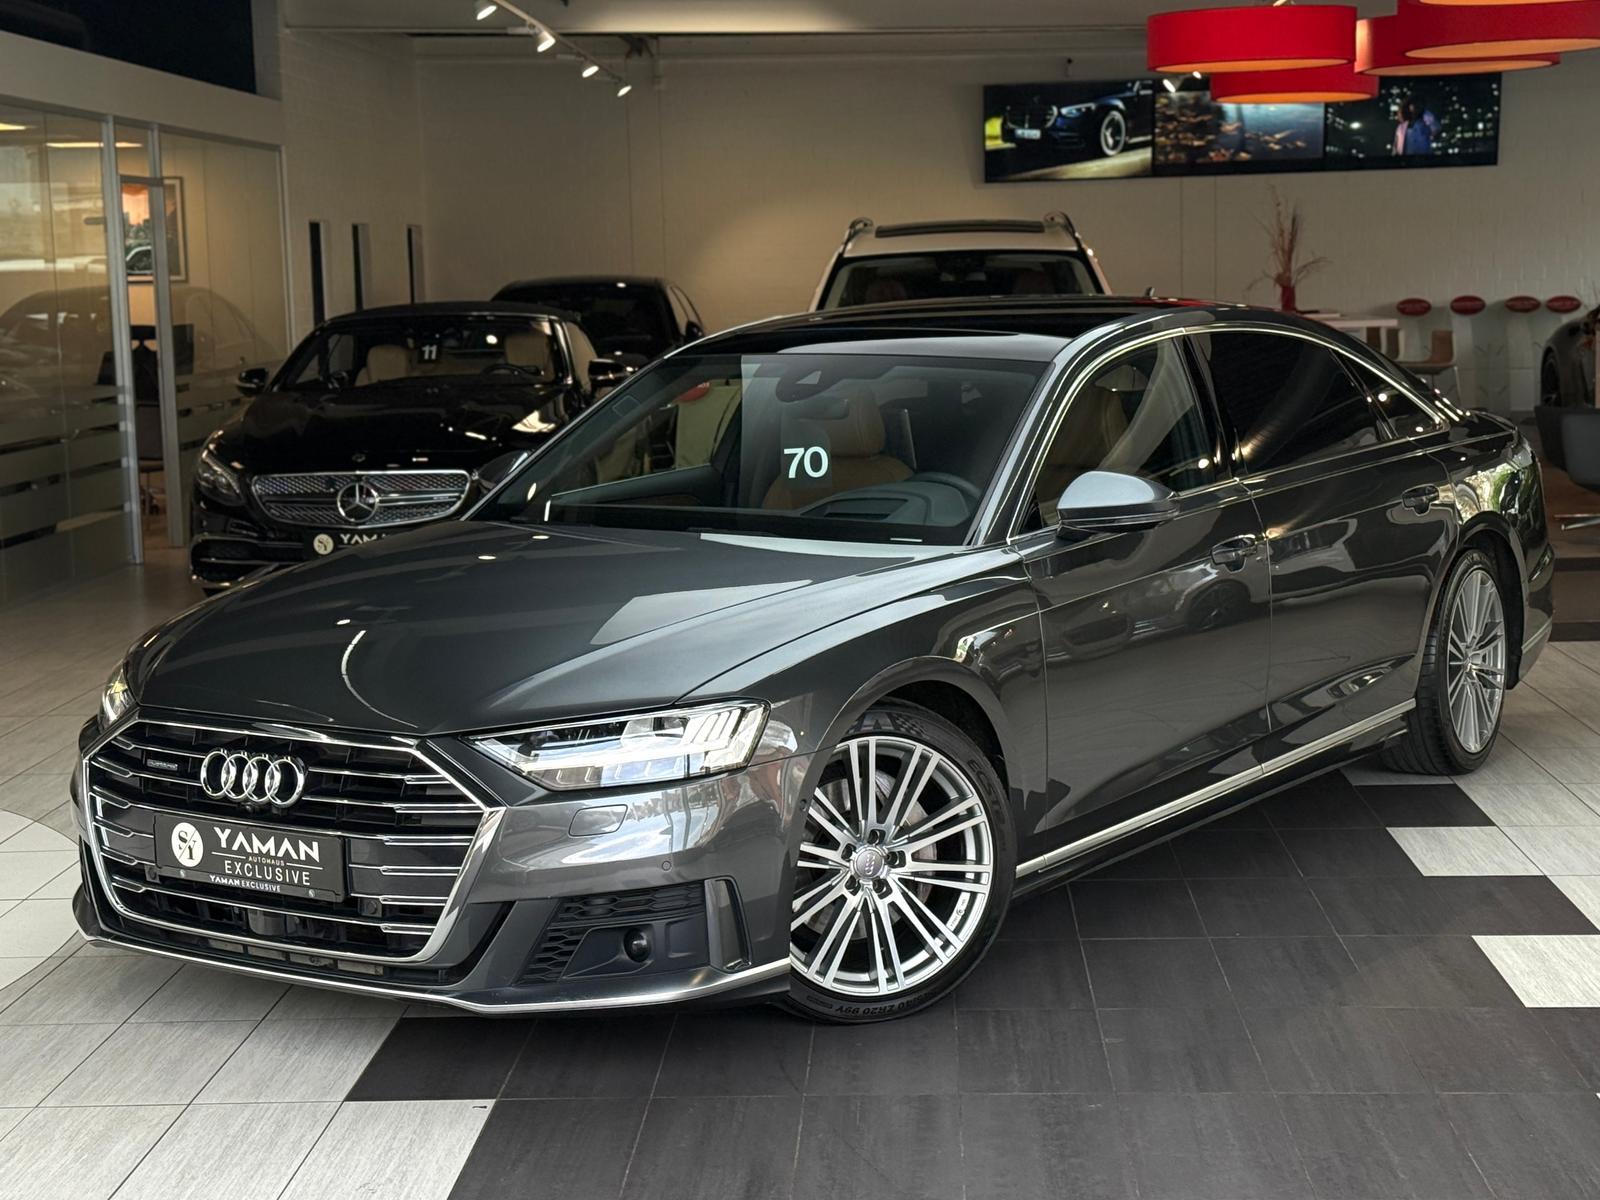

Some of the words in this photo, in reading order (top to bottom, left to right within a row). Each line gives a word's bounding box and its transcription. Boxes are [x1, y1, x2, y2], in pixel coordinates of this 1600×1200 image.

[421, 344, 438, 360] 11
[783, 446, 829, 479] 70
[340, 533, 391, 545] YAM
[213, 826, 320, 863] YAMAN
[248, 856, 285, 867] AUTOHAUS
[224, 860, 311, 886] EXCLUSIVE
[209, 874, 241, 888] YAMAN
[241, 880, 281, 893] EXCLUSIVE
